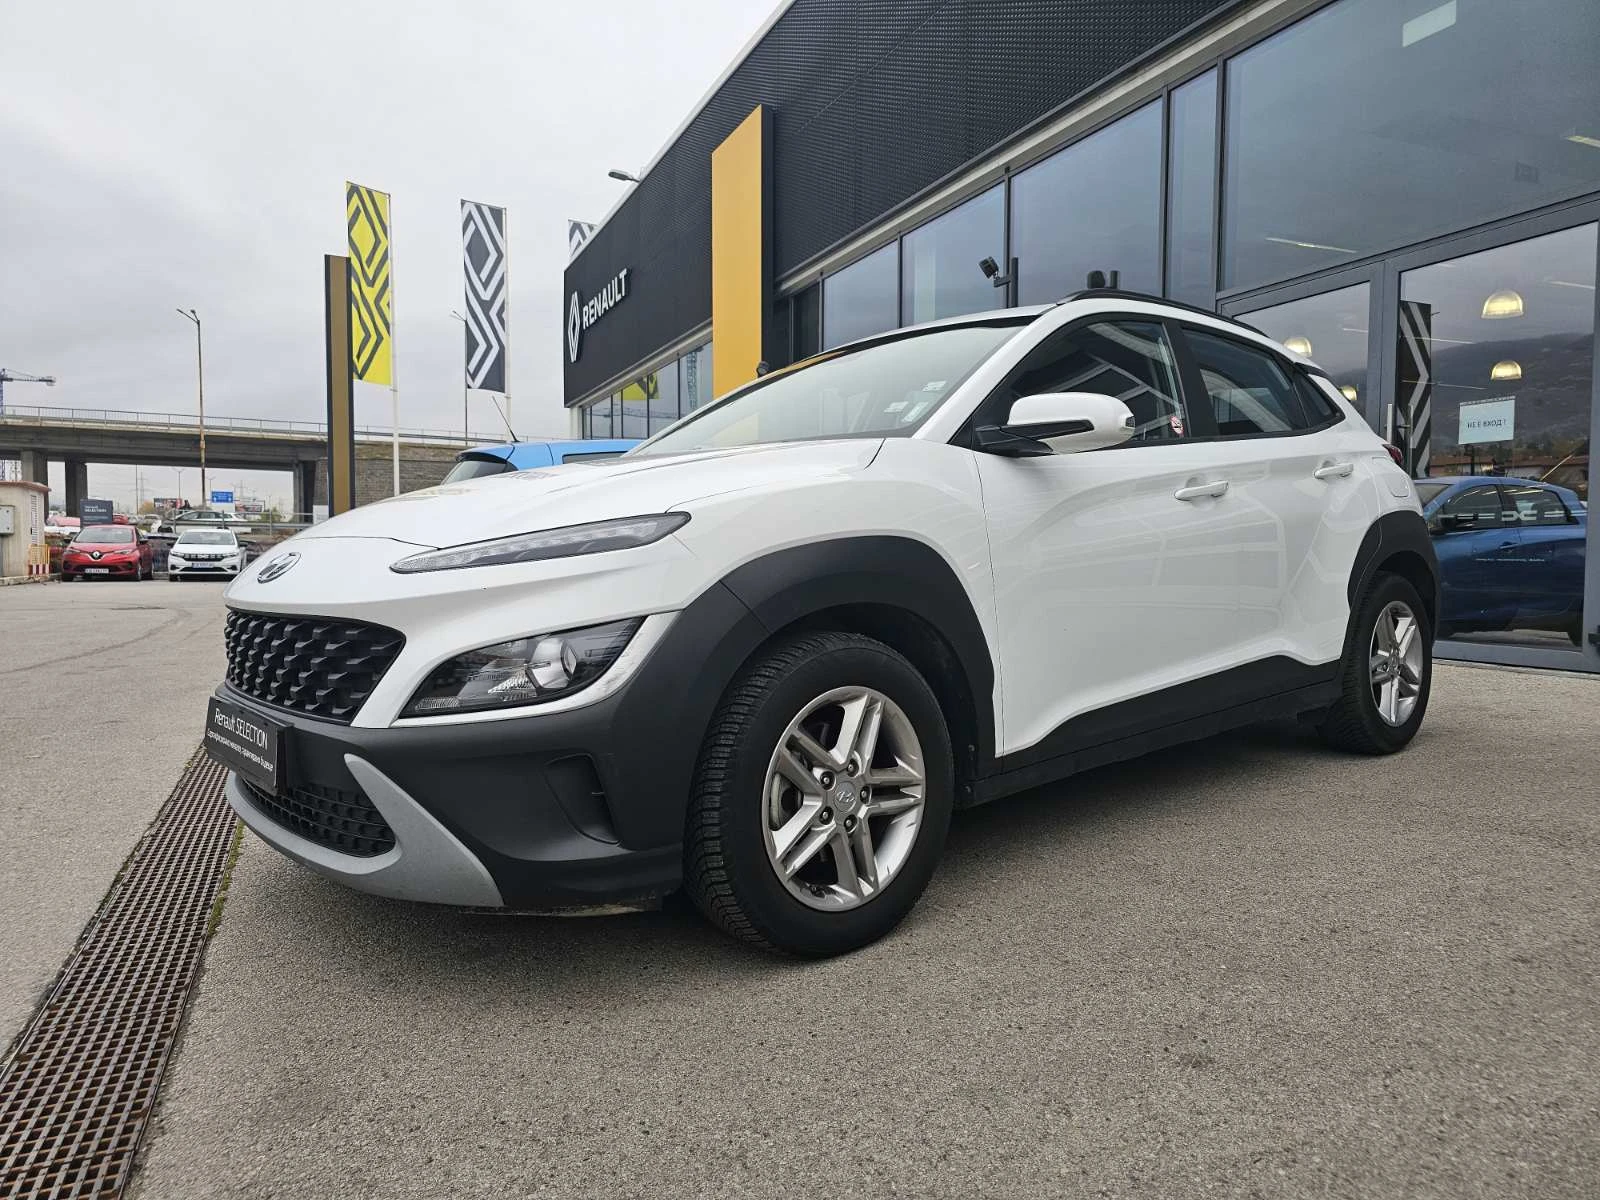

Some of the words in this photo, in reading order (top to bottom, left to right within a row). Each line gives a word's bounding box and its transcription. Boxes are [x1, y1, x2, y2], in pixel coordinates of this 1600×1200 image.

[582, 267, 628, 330] RENAULT
[215, 707, 235, 733] Renault
[235, 718, 268, 751] SELECTION
